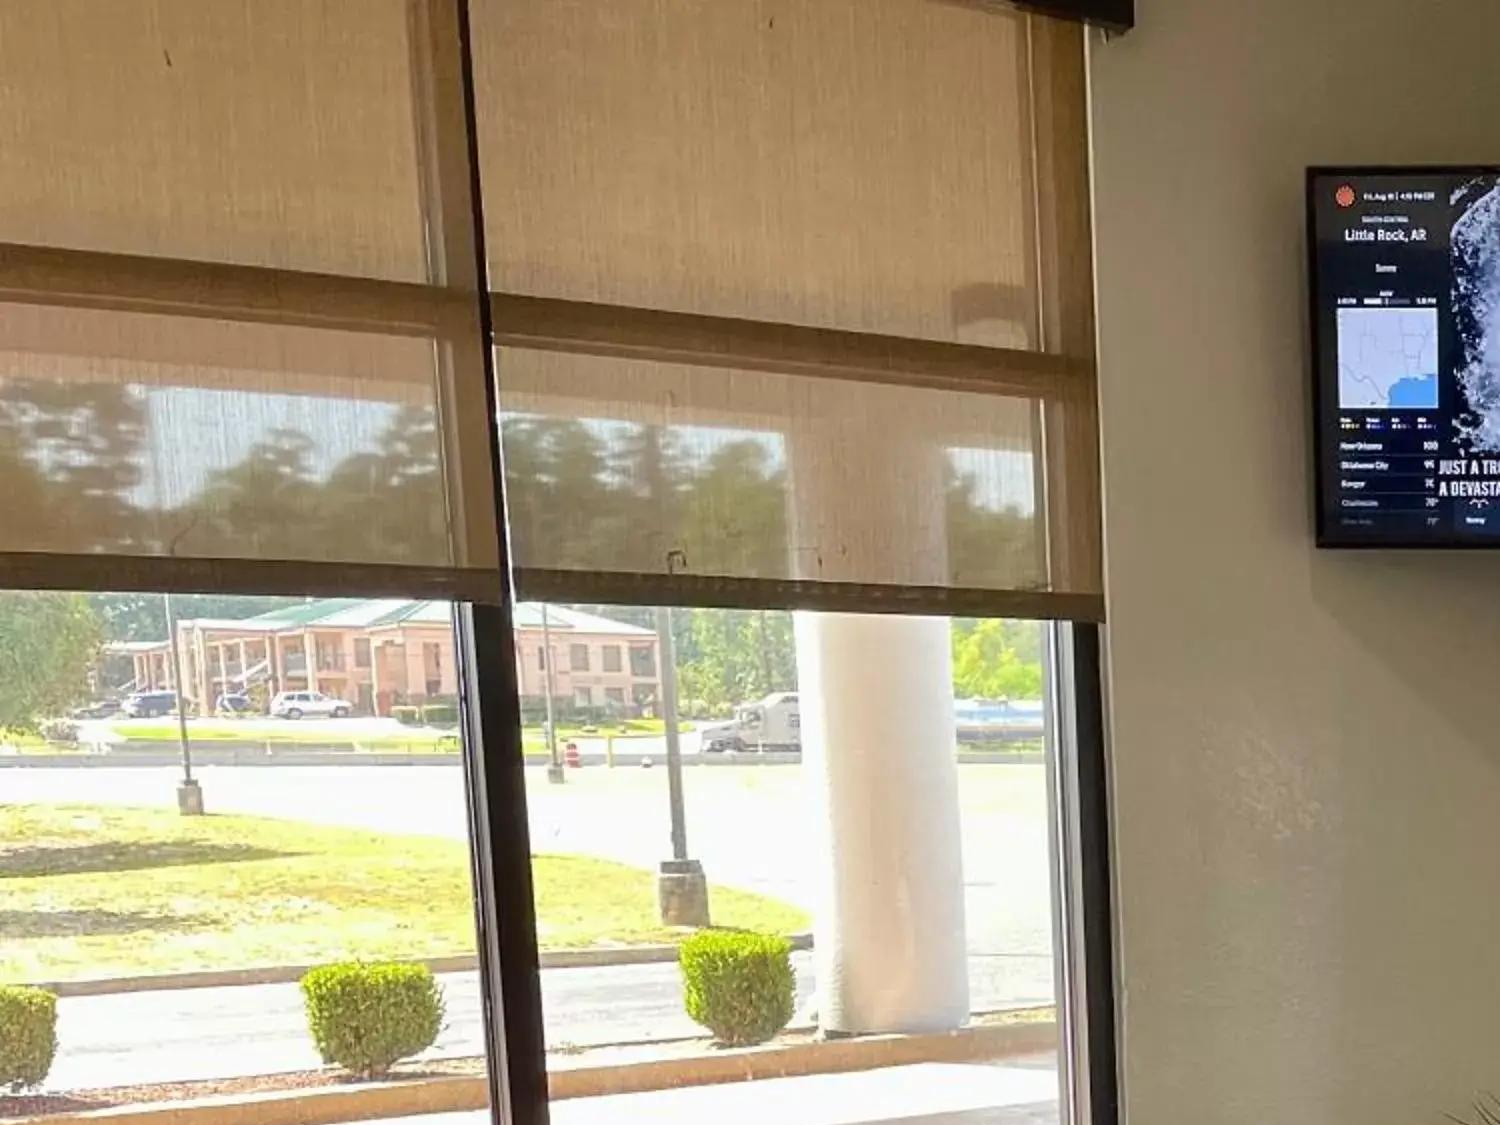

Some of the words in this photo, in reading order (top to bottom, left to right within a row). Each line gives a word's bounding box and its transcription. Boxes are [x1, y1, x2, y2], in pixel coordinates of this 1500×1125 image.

[1344, 228, 1375, 241] Little
[1377, 228, 1409, 243] Rock,
[1410, 228, 1427, 241] AR
[1439, 459, 1467, 475] JUST
[1470, 459, 1480, 475] A
[1439, 481, 1449, 497] A
